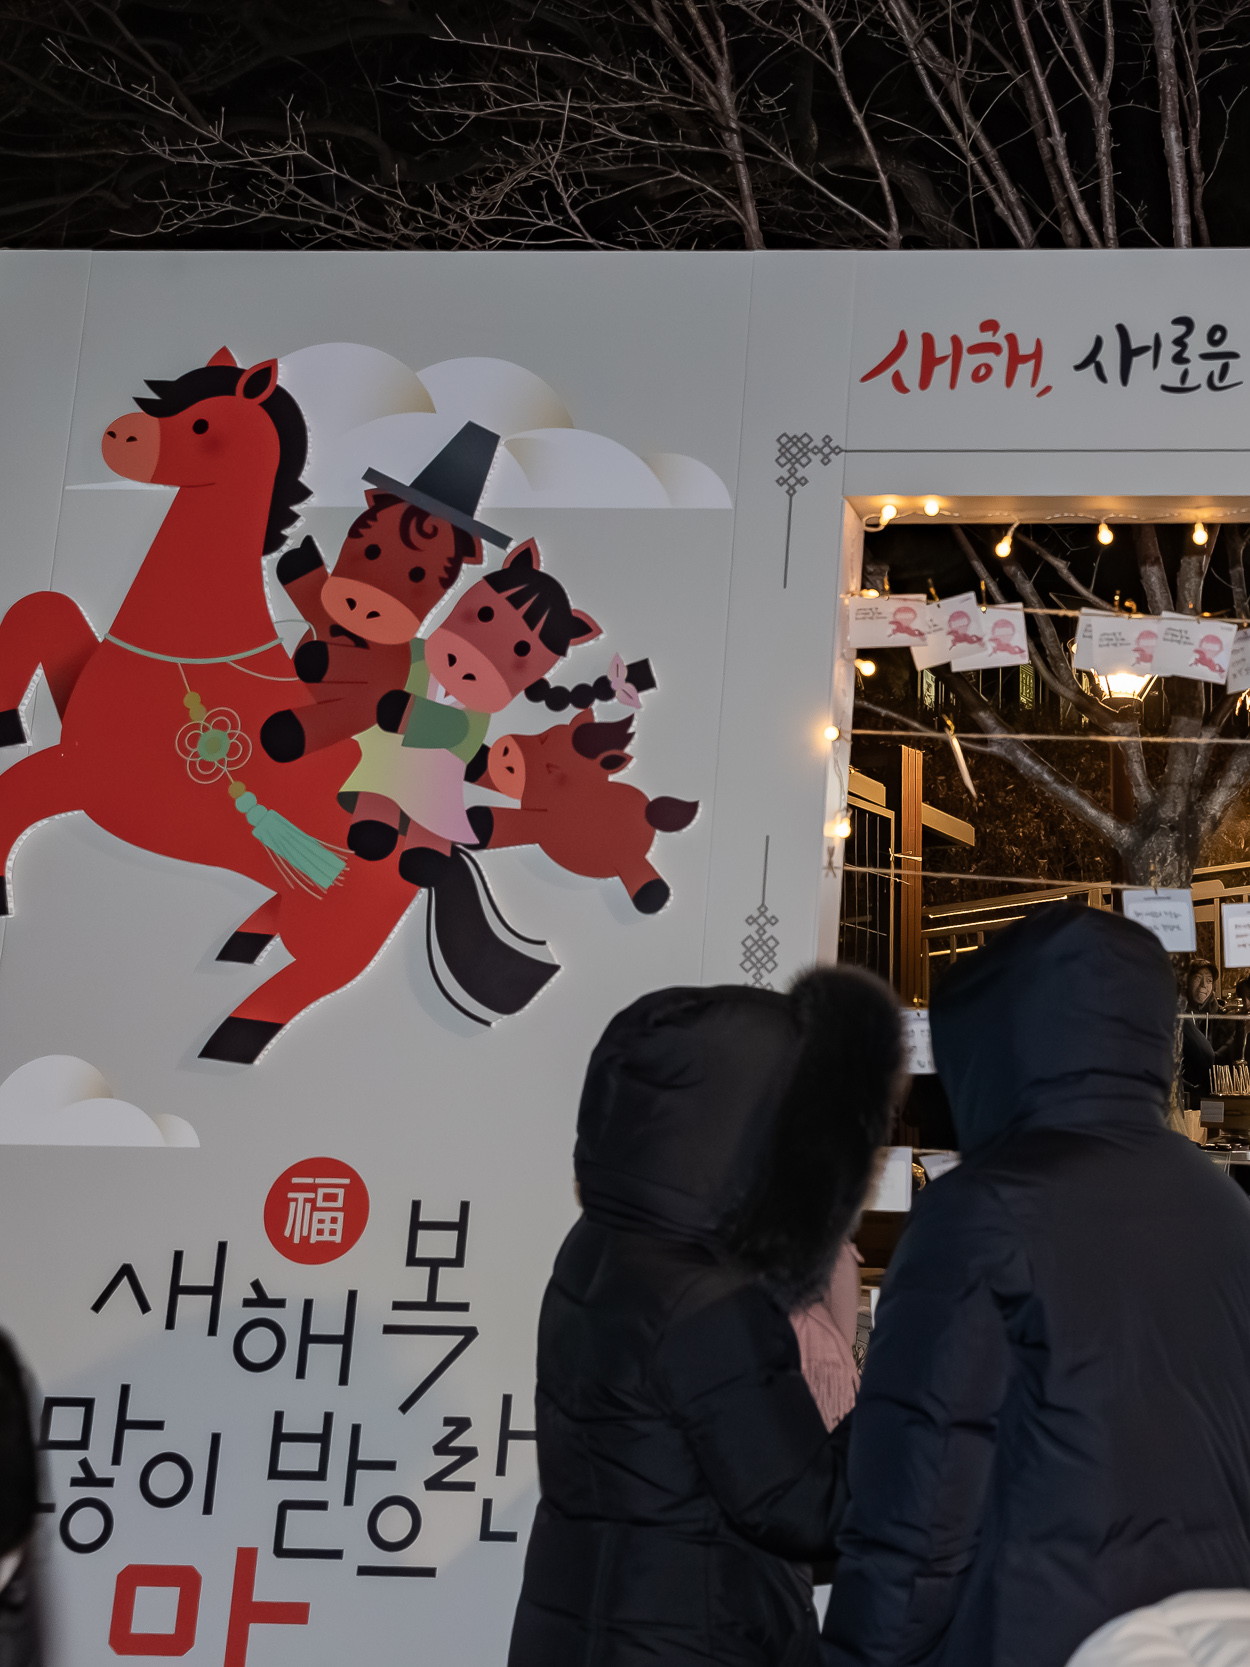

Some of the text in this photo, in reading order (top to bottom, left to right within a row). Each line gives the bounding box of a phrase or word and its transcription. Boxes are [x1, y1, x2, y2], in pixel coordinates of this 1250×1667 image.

[861, 319, 1052, 397] 새해,
[1074, 316, 1243, 394] 새로운
[284, 1177, 350, 1244] 福
[90, 1199, 479, 1415] 새해 복
